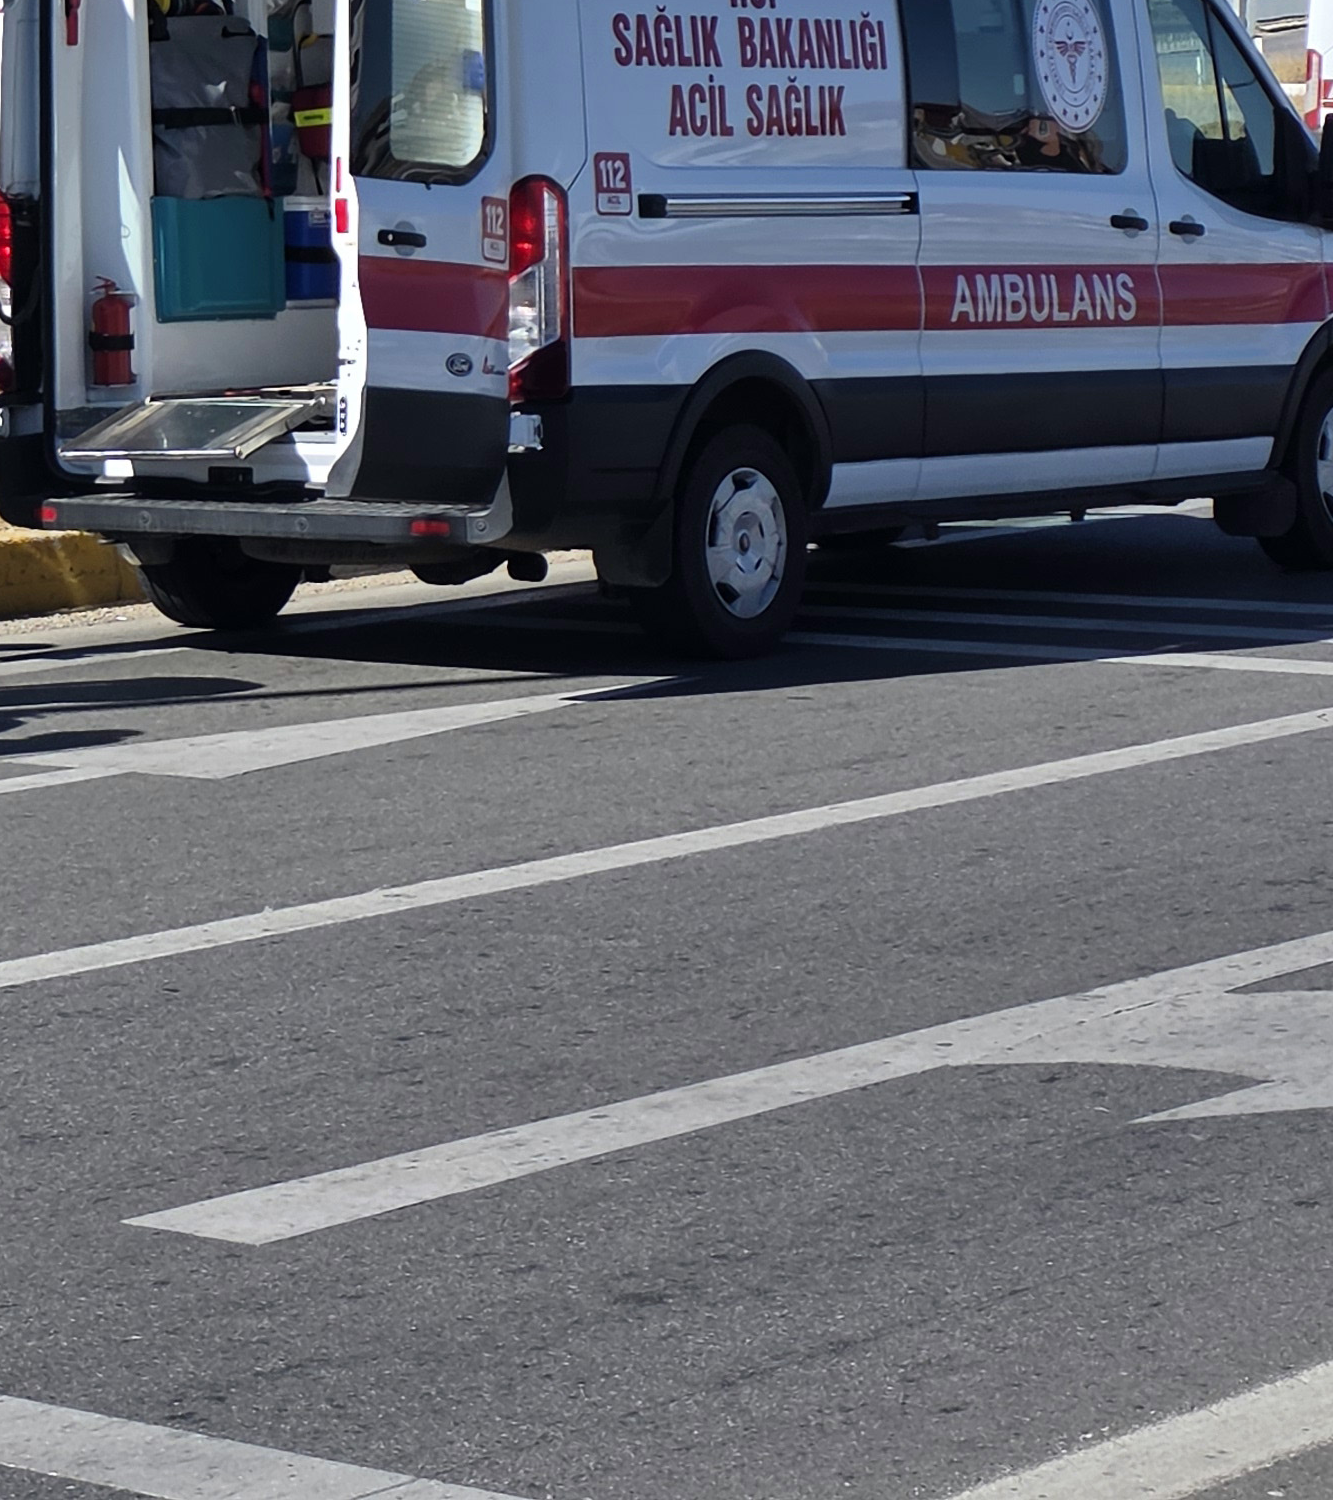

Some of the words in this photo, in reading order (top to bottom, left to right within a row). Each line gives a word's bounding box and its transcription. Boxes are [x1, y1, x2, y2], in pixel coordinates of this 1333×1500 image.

[612, 5, 723, 67] SAĞLIK
[737, 11, 888, 69] BAKANLIĞI
[669, 74, 734, 137] ACİL
[746, 75, 847, 137] SAĞLIK
[599, 159, 626, 188] 112
[485, 204, 505, 235] 112
[951, 273, 1137, 322] AMBULANS
